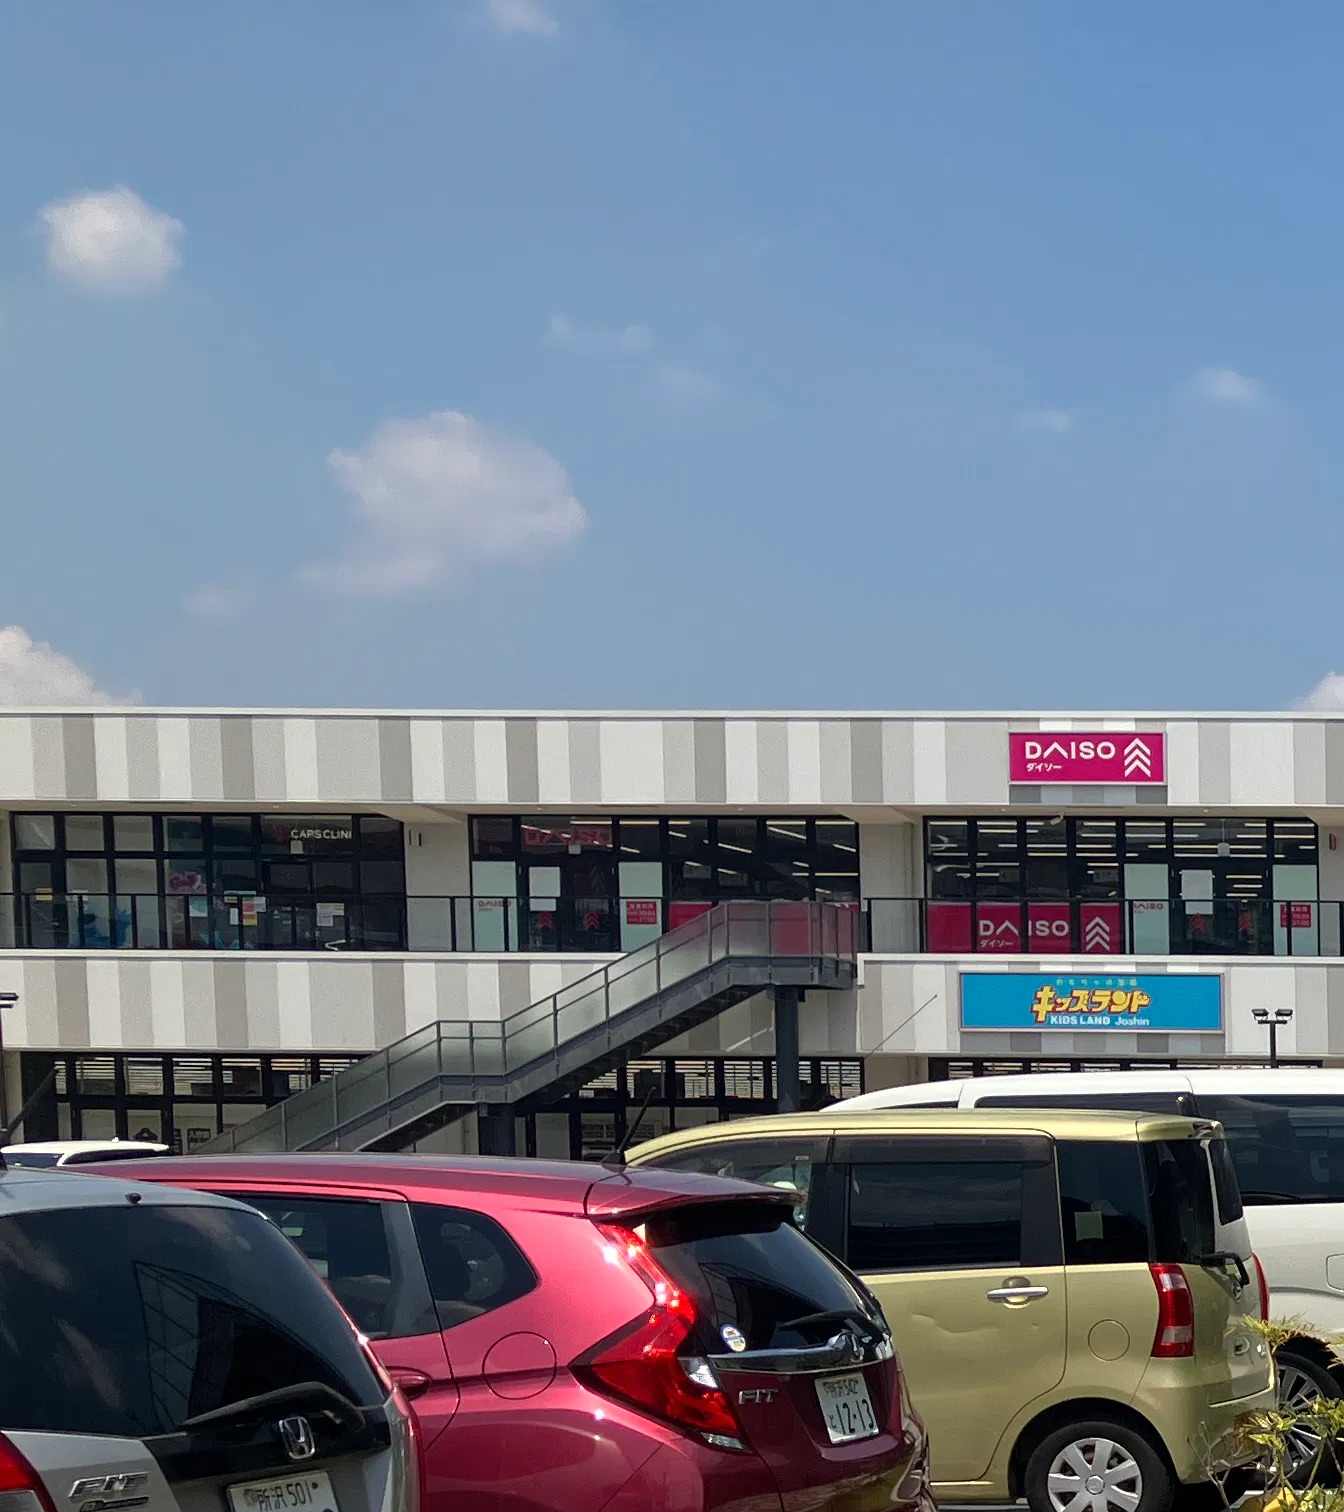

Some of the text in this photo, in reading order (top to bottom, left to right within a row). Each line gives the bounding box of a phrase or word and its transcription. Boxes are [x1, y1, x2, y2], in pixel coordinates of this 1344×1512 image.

[1024, 741, 1116, 760] DAISO
[1025, 762, 1063, 773] ダイソー
[979, 919, 1070, 937] DAISO
[1031, 984, 1152, 1023] キッズランド
[1050, 1015, 1078, 1025] KIDS
[1080, 1015, 1111, 1025] LAND
